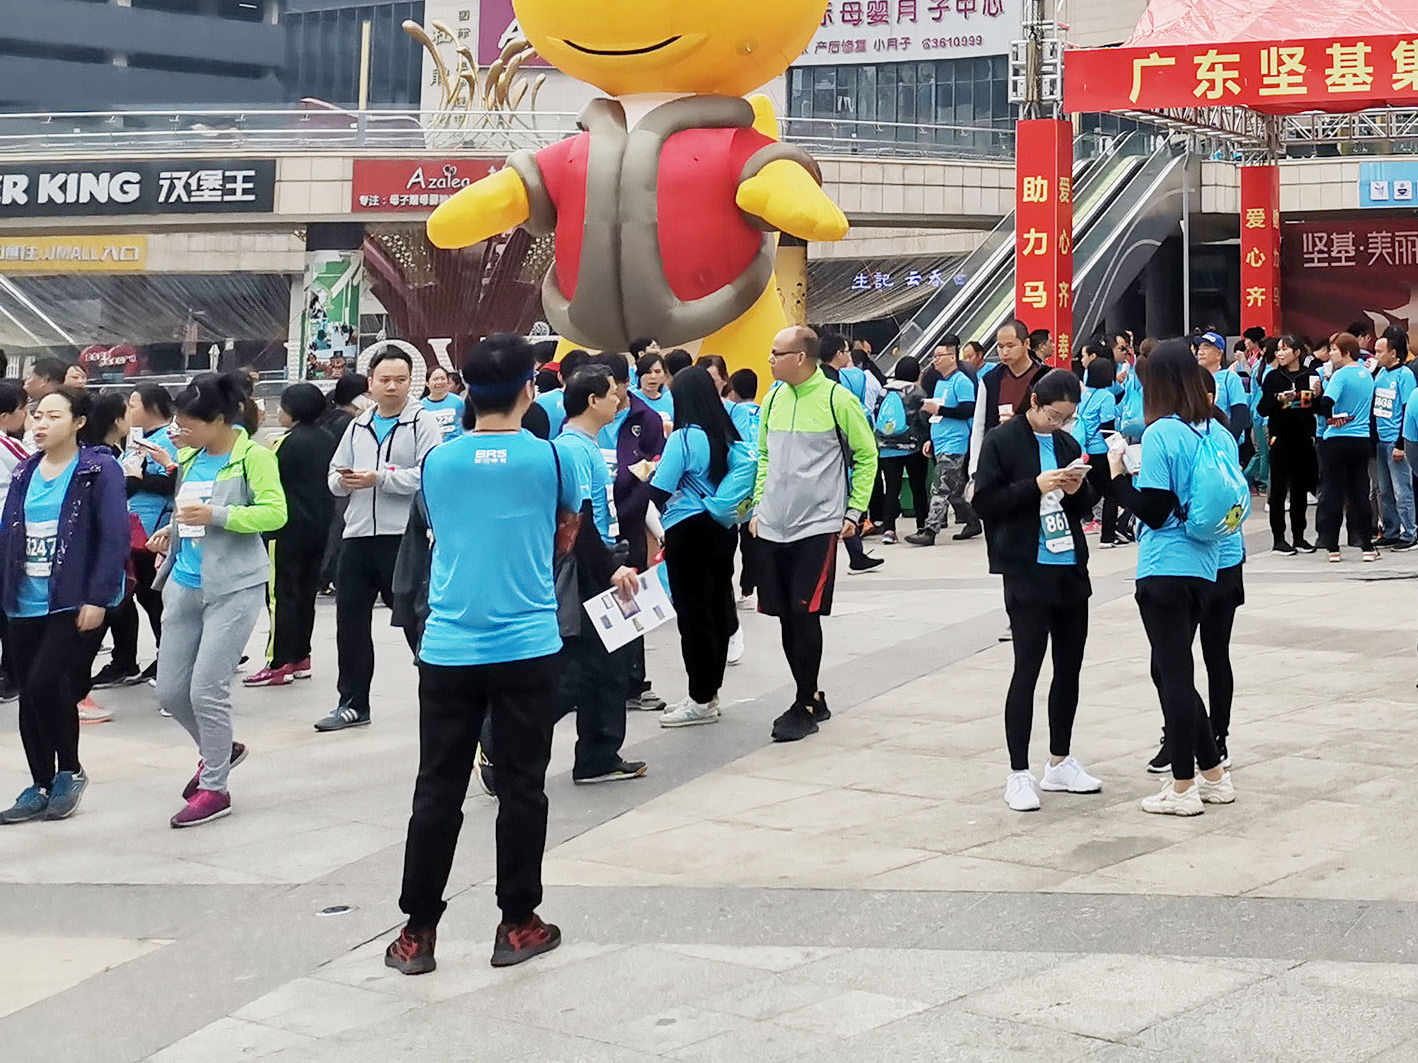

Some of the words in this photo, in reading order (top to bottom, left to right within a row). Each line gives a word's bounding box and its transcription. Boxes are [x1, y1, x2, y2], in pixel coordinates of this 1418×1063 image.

[0, 174, 29, 205] R
[38, 172, 142, 204] KING
[157, 170, 256, 203] 汉堡王
